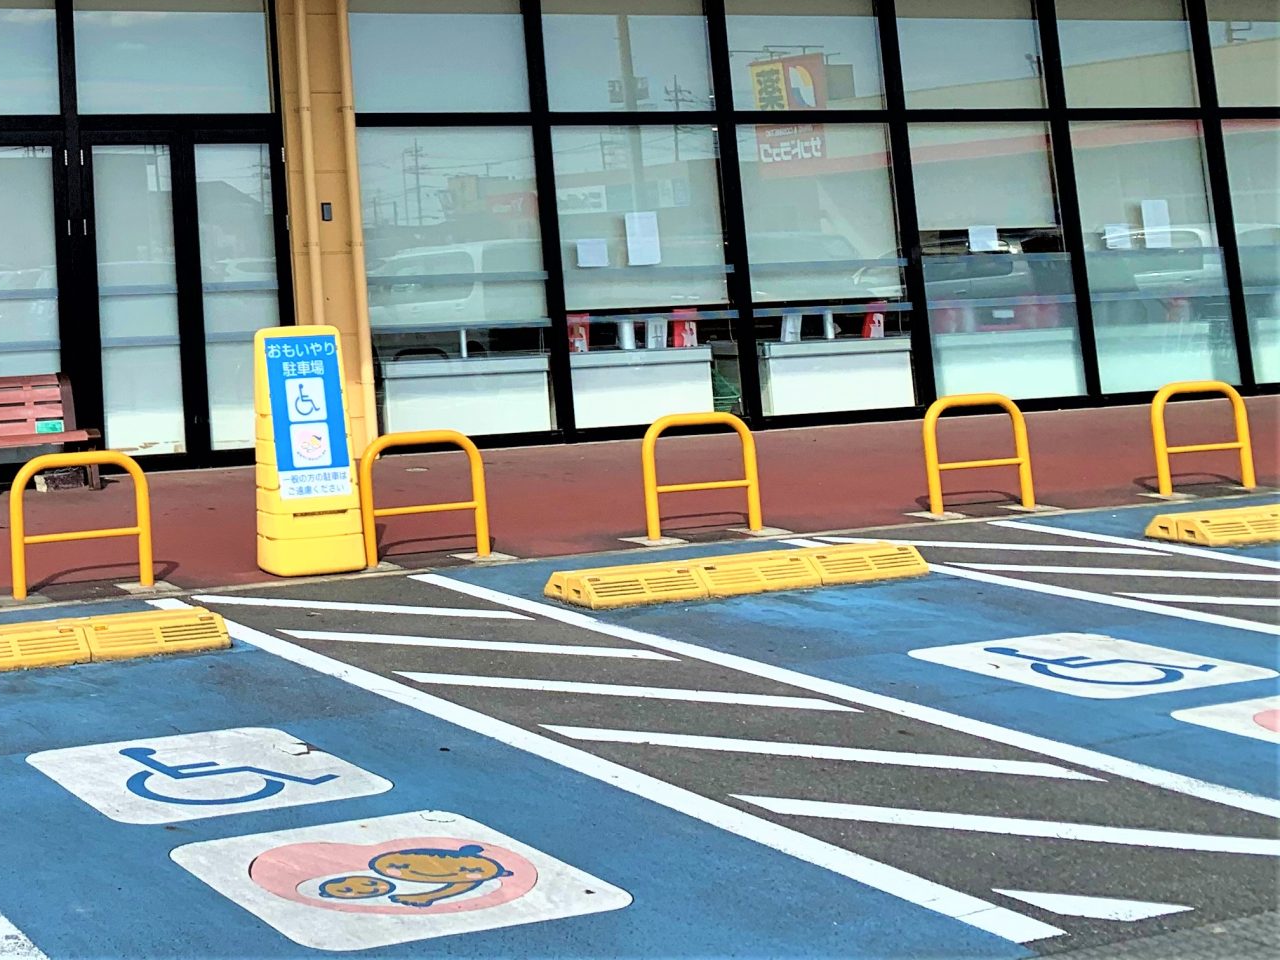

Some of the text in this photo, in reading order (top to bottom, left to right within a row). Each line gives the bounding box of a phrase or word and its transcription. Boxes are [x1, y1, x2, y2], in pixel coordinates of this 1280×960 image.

[267, 341, 336, 359] おもいやり
[282, 359, 325, 377] 駐車場
